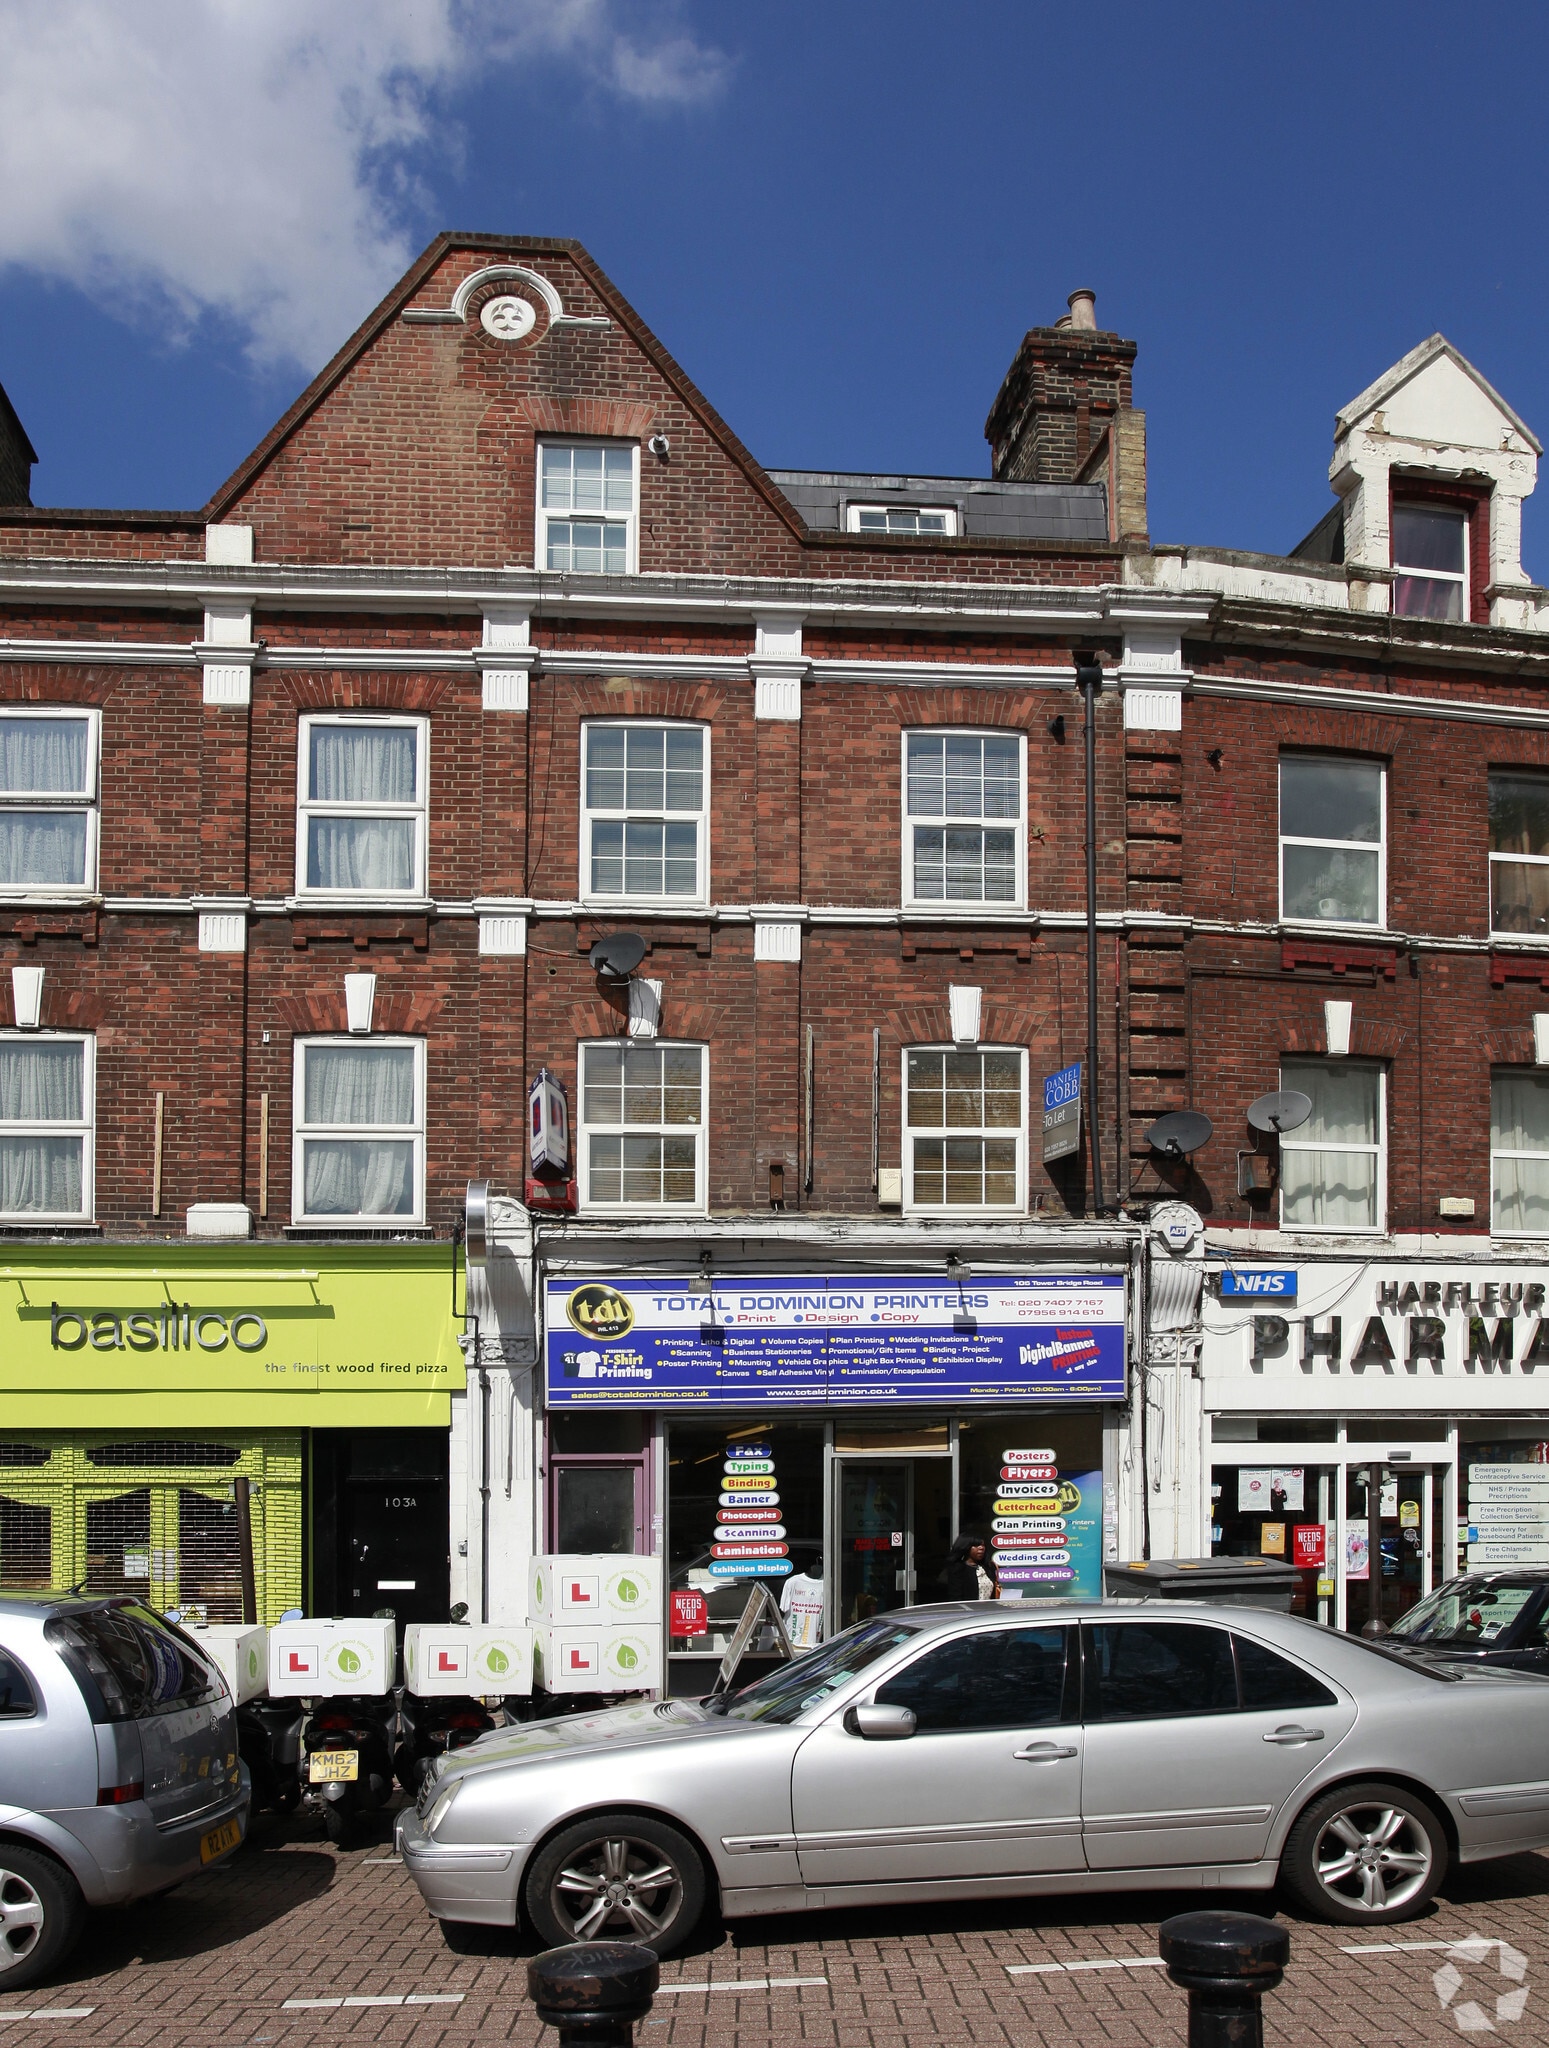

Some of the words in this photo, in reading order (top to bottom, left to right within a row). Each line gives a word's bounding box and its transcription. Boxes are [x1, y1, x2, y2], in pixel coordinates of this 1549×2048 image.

[1046, 1069, 1078, 1091] DANIEL
[1046, 1080, 1077, 1106] COBB
[1044, 1115, 1052, 1127] To
[1054, 1109, 1065, 1123] Let
[1170, 1227, 1186, 1236] ADT
[1234, 1275, 1286, 1292] NHS
[1376, 1280, 1546, 1304] HARFLEUR
[653, 1297, 730, 1311] TOTAL
[740, 1295, 864, 1310] DOMINION
[874, 1294, 988, 1309] PRINTERS
[737, 1314, 776, 1322] Print
[805, 1314, 858, 1323] Design
[881, 1313, 919, 1323] Copy
[51, 1302, 267, 1348] basilico
[895, 1336, 928, 1344] Wedding
[1056, 1328, 1093, 1341] Instant
[663, 1339, 694, 1347] Printing
[730, 1338, 755, 1346] Digital
[564, 1356, 575, 1364] 41
[601, 1353, 643, 1365] T-Shirt
[691, 1360, 722, 1368] Printing
[734, 1359, 771, 1367] Mounting
[812, 1358, 848, 1366] Graphics
[896, 1357, 926, 1365] Printing
[976, 1356, 1003, 1364] Display
[1052, 1346, 1101, 1371] PRINTING
[265, 1363, 286, 1373] the
[293, 1362, 330, 1373] finest
[336, 1363, 374, 1373] wood
[380, 1362, 411, 1373] fired
[416, 1363, 448, 1375] pizza
[598, 1365, 652, 1380] Printing
[847, 1367, 945, 1376] Lamination/Encapsulation
[571, 1391, 709, 1399] sales@totaldominion.co.uk
[766, 1388, 897, 1396] www.totaldominion.co.uk
[735, 1445, 763, 1456] Fax
[1008, 1452, 1050, 1460] Posters
[731, 1462, 769, 1473] Typing
[1007, 1467, 1052, 1479] Flyers
[728, 1479, 771, 1489] Binding
[1002, 1485, 1054, 1495] Invoices
[385, 1497, 417, 1507] 103A
[728, 1495, 770, 1504] Banner
[998, 1503, 1056, 1512] Letterhead
[722, 1511, 777, 1521] Photocopies
[997, 1521, 1019, 1529] Plan
[1022, 1520, 1062, 1530] Printing
[724, 1528, 777, 1539] Scanning
[1298, 1532, 1321, 1542] NEEDS
[997, 1537, 1036, 1545] Business
[1038, 1536, 1065, 1544] Cards
[716, 1544, 783, 1556] Lamination
[1302, 1542, 1316, 1552] YOU
[999, 1554, 1038, 1562] Wedding
[1040, 1553, 1066, 1561] Cards
[713, 1565, 755, 1573] Exhibition
[757, 1563, 789, 1574] Display
[998, 1571, 1030, 1579] Vehicle
[1032, 1570, 1071, 1579] Graphics
[572, 1583, 590, 1602] L
[626, 1586, 637, 1602] b
[676, 1598, 702, 1609] NEEDS
[681, 1609, 697, 1620] YOU
[289, 1653, 309, 1672] L
[348, 1656, 360, 1672] b
[439, 1652, 458, 1671] L
[496, 1656, 508, 1672] b
[571, 1650, 590, 1669] L
[626, 1653, 637, 1668] b
[311, 1753, 357, 1766] KM62
[318, 1766, 351, 1779] JHZ
[208, 1833, 221, 1855] R2
